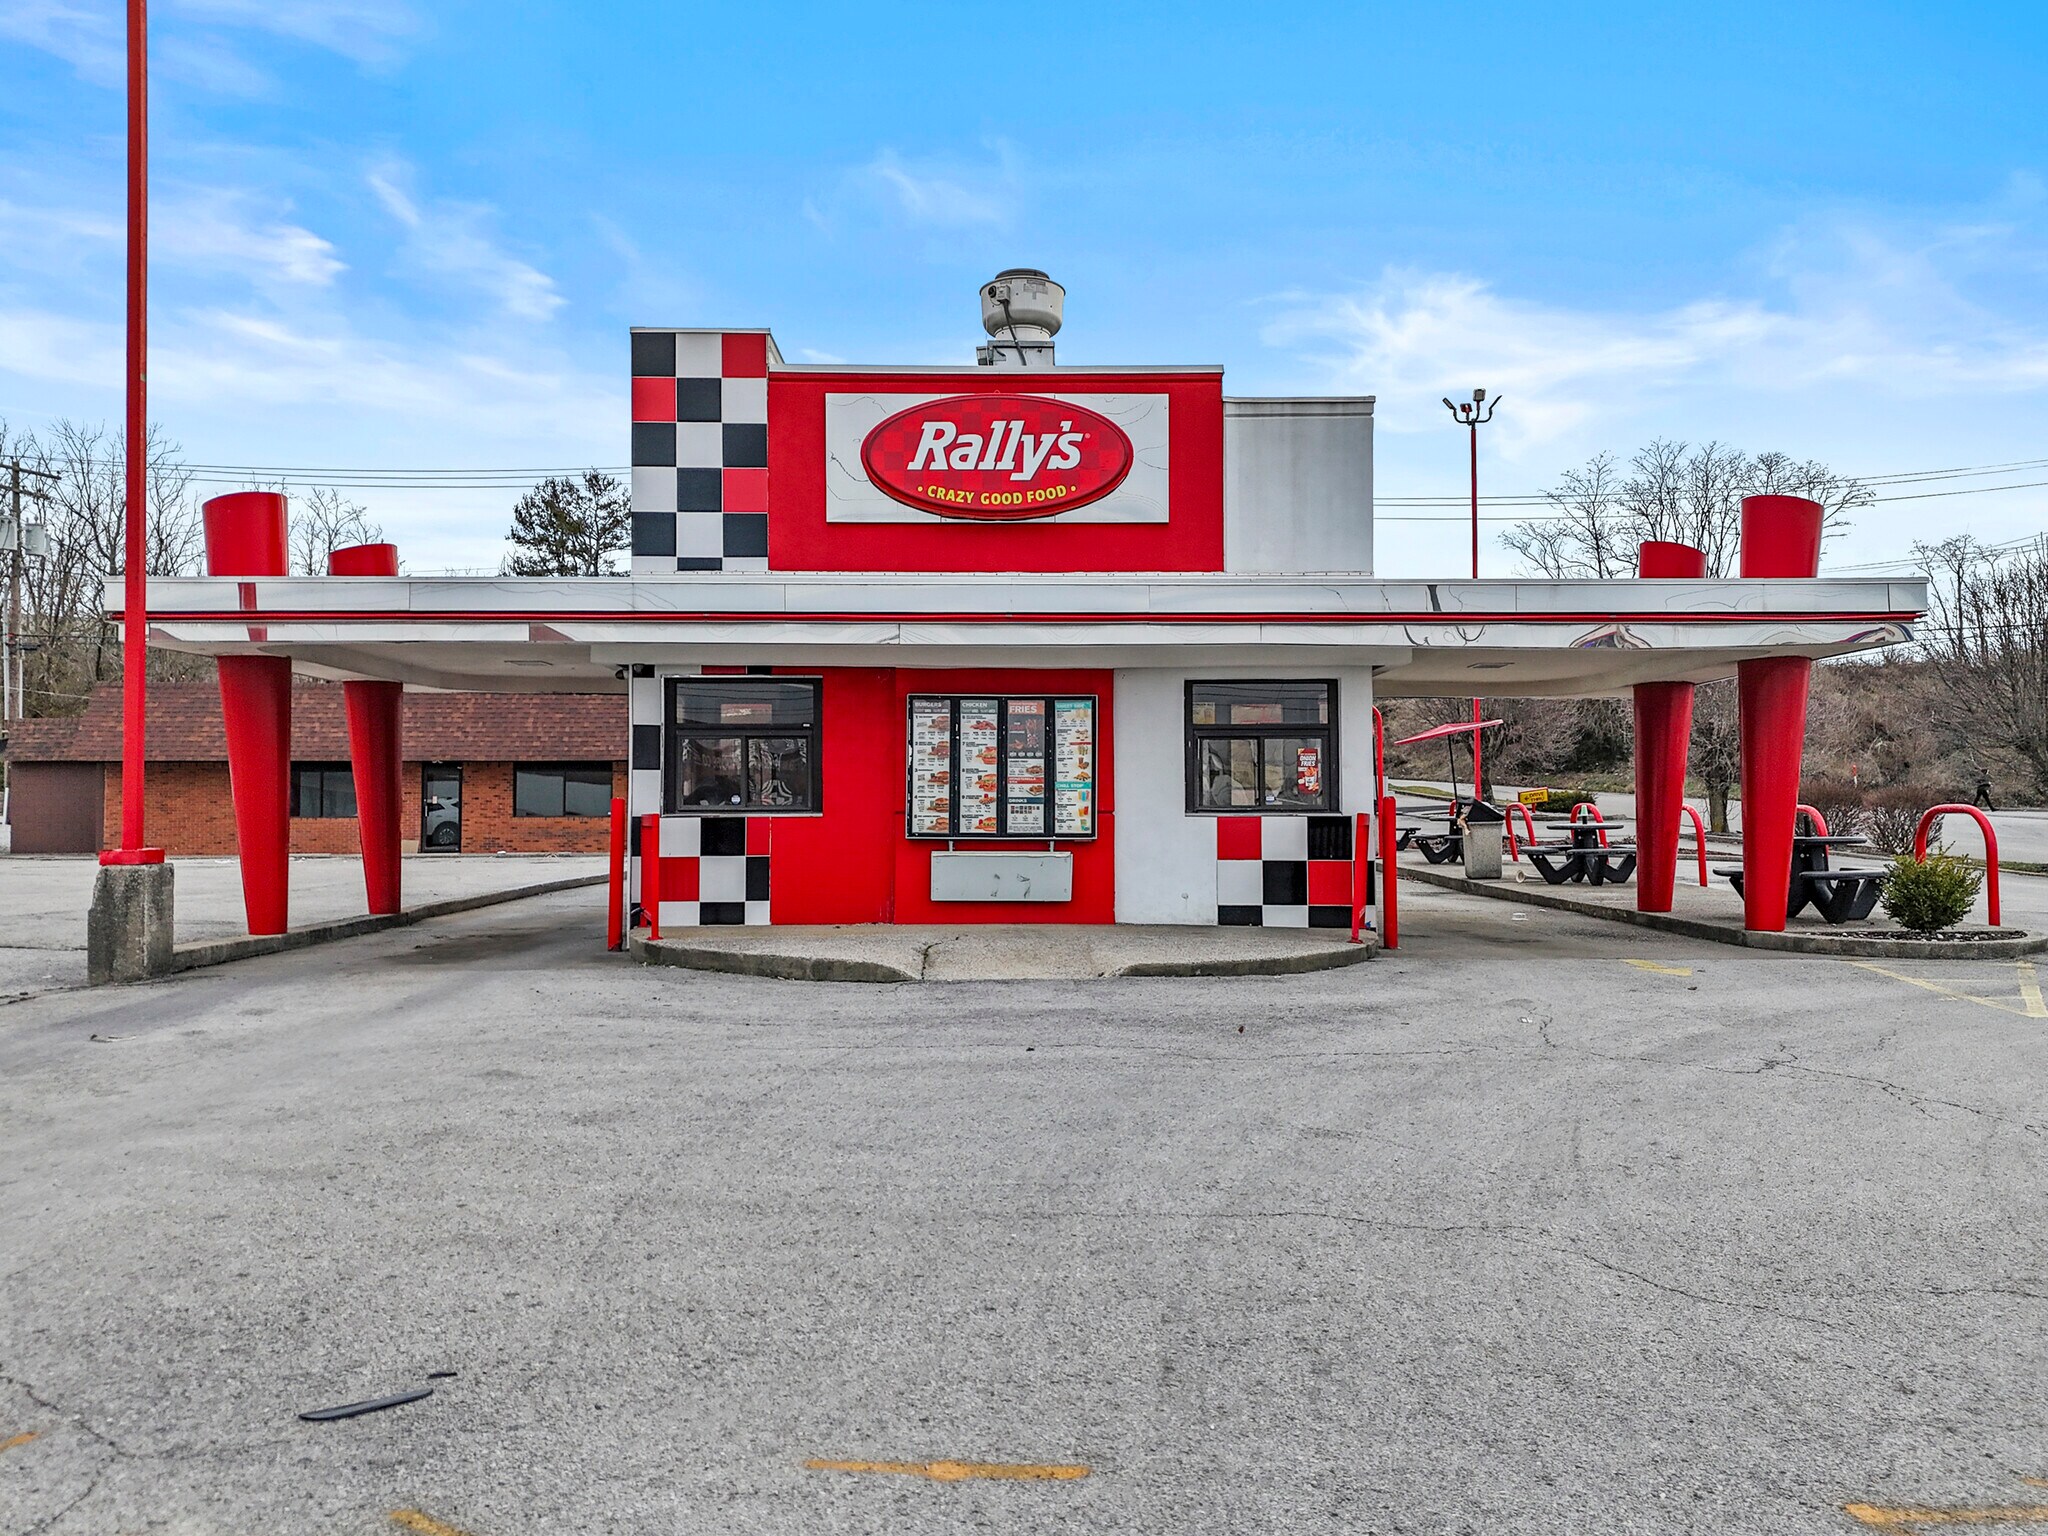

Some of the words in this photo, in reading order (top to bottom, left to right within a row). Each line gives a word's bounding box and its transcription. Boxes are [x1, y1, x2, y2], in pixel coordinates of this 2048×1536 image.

[907, 420, 1083, 480] Rally's
[927, 486, 975, 504] CRAZY
[981, 491, 1024, 505] GOOD
[1026, 485, 1067, 503] FOOD
[1009, 705, 1037, 713] FRIES
